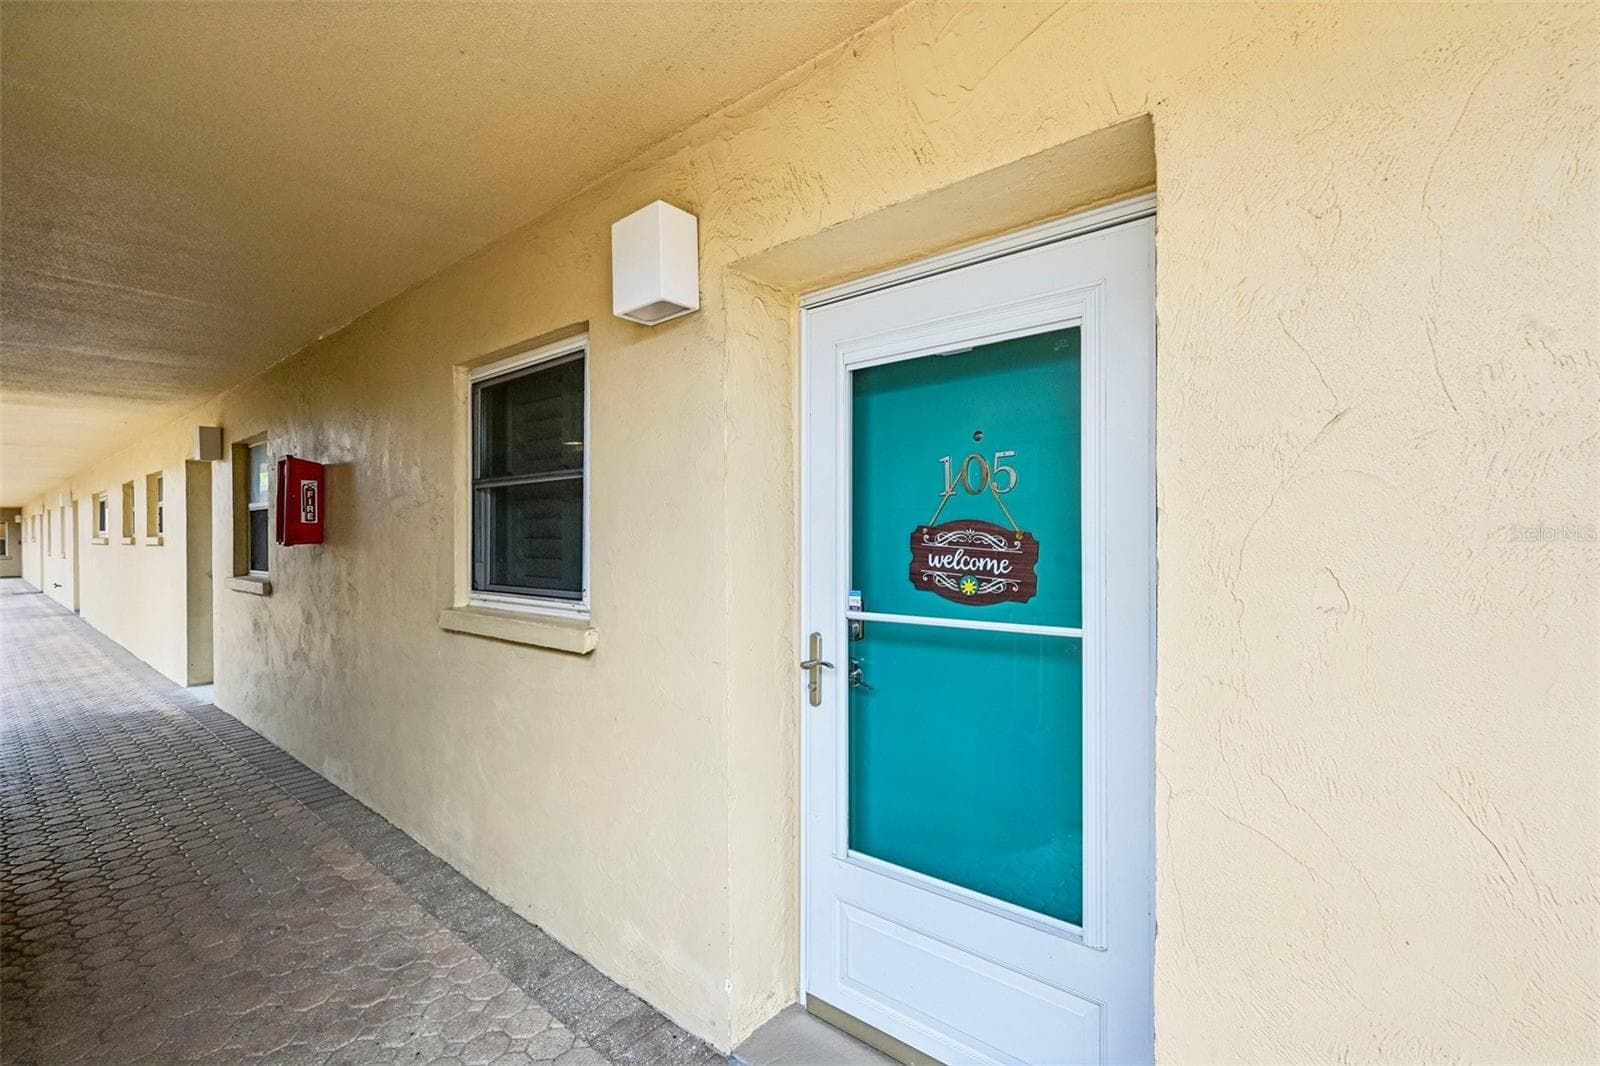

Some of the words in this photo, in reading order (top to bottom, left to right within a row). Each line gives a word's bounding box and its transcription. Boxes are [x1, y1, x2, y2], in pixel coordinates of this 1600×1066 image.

[938, 450, 1018, 496] 105
[306, 490, 314, 520] FIRE
[928, 548, 1013, 575] welcome
